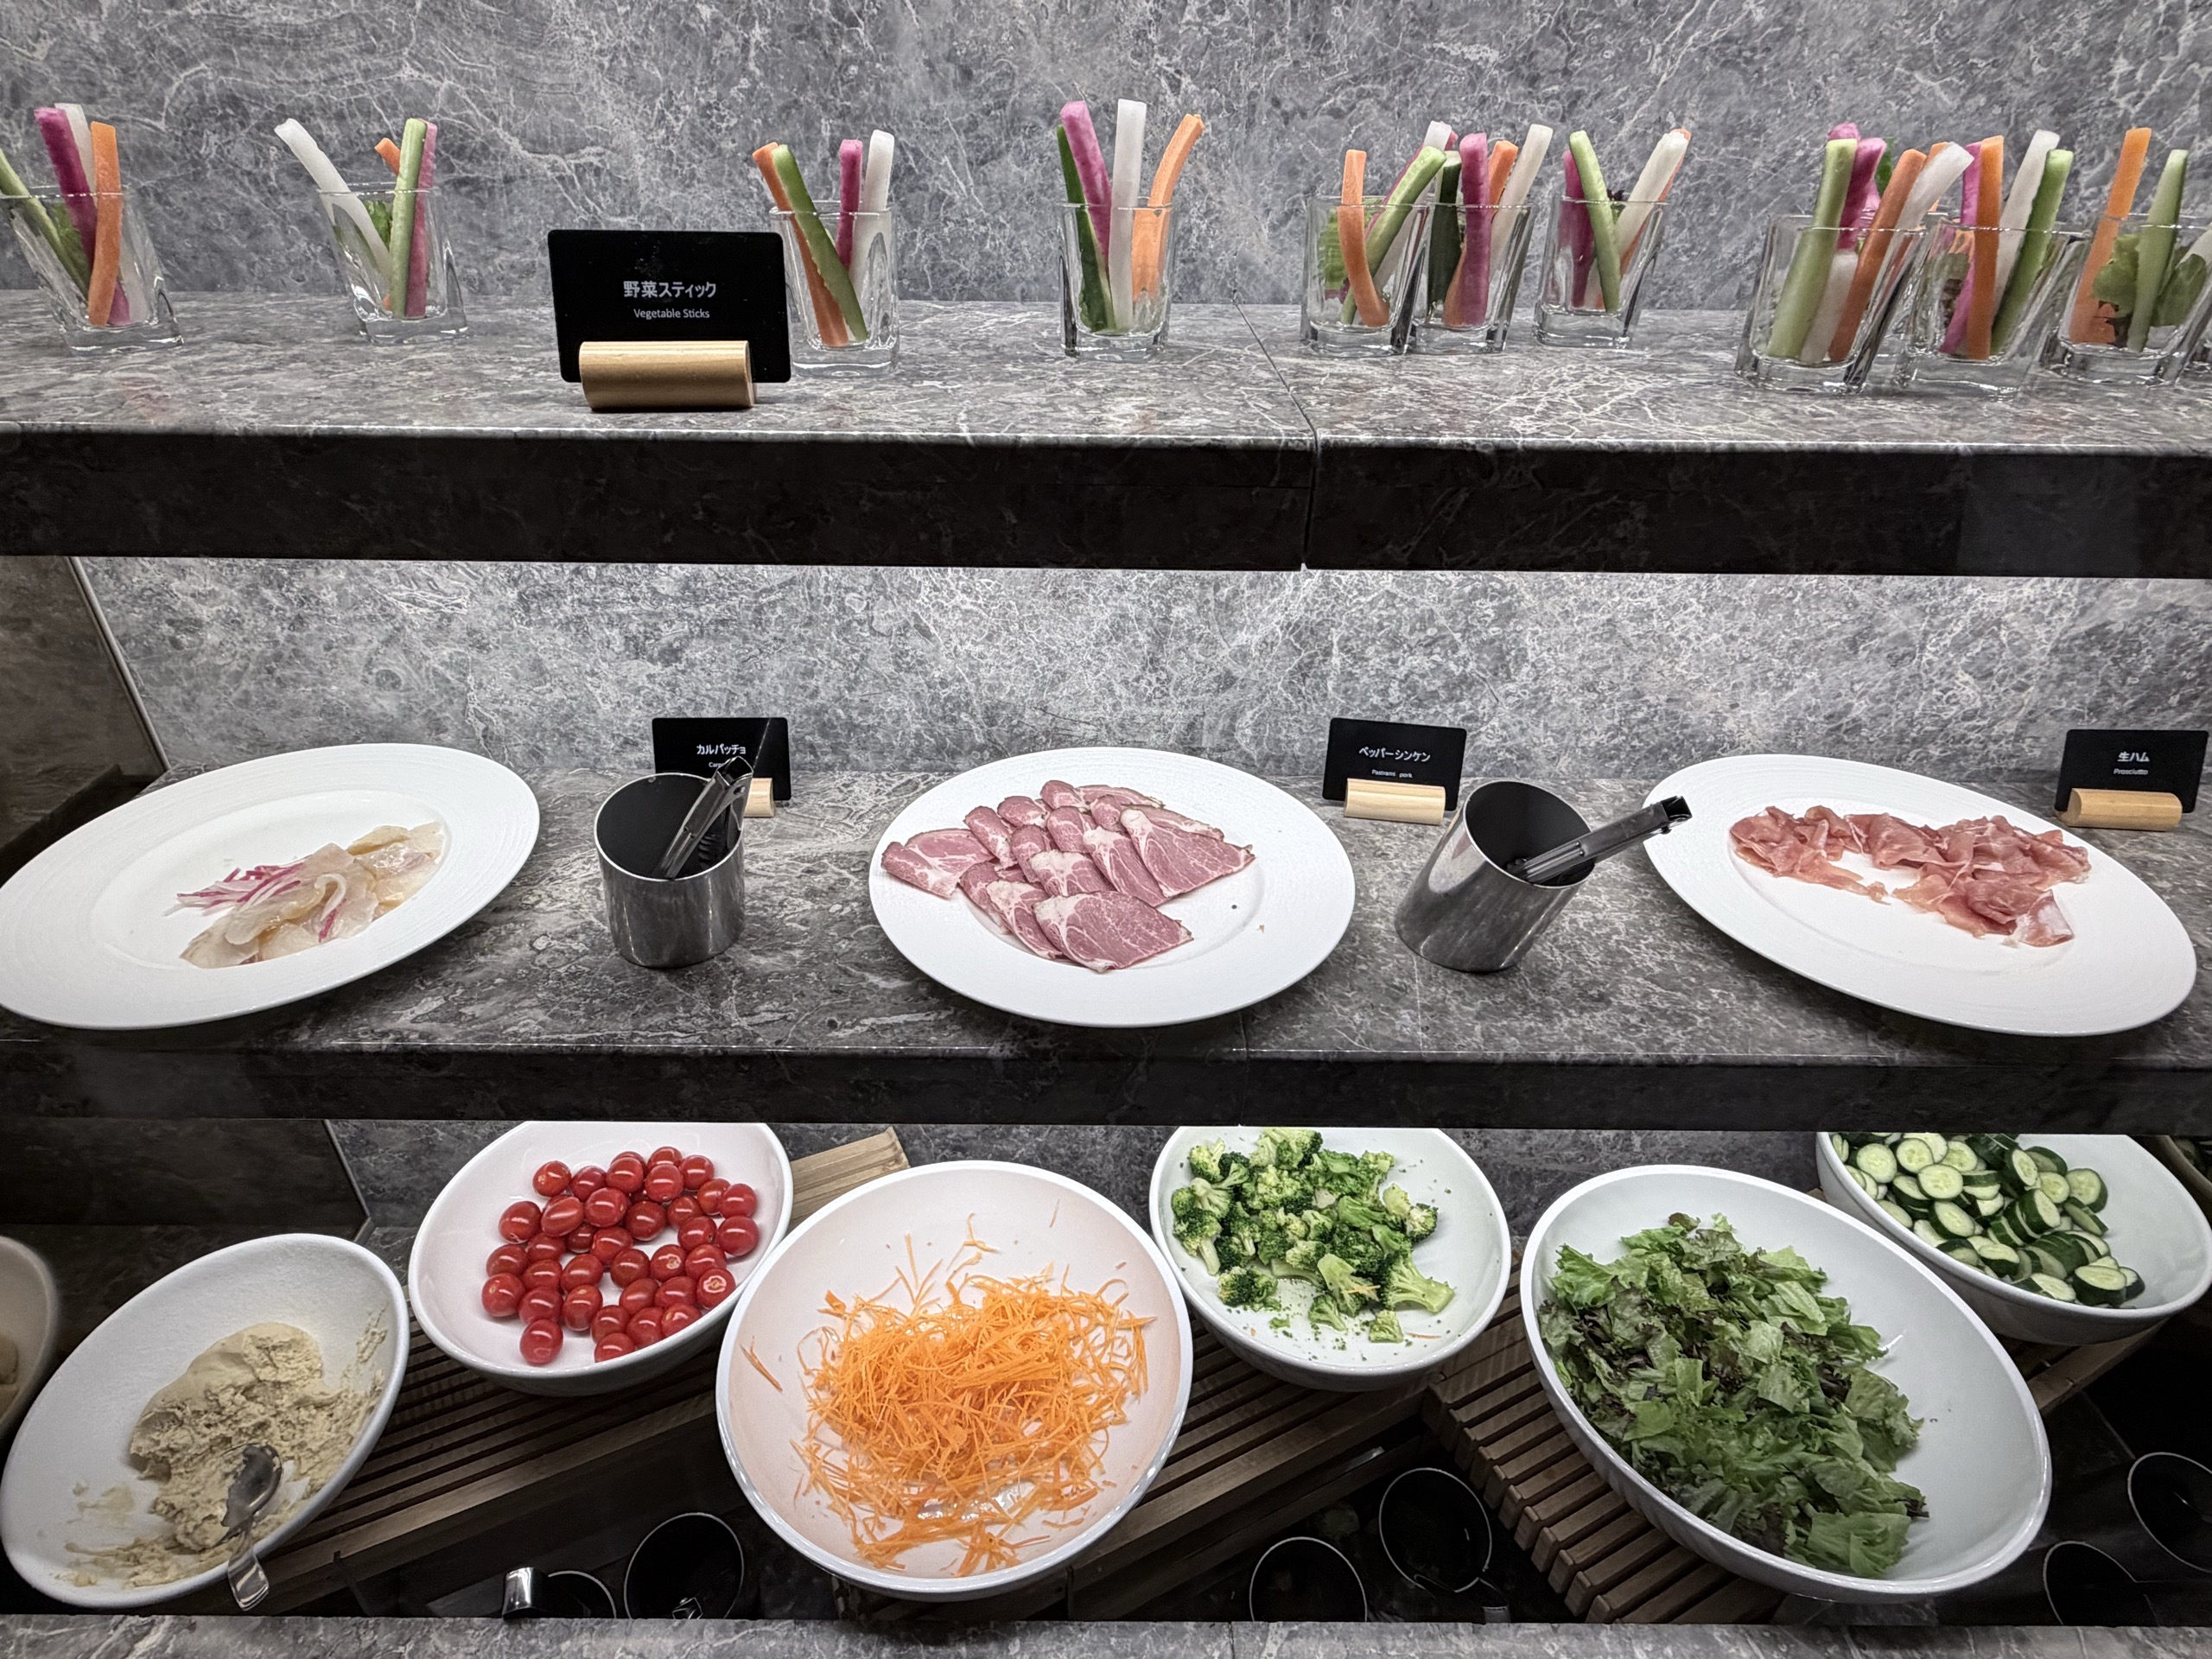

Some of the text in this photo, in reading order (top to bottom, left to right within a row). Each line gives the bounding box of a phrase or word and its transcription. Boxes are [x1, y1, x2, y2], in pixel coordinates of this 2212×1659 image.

[623, 280, 716, 298] 野菜スティック
[632, 308, 710, 321] Vegetable Sticks
[696, 743, 747, 755] カルパッチョ
[1358, 746, 1431, 762] ペッパーシンケン
[2117, 751, 2150, 762] 生ハム
